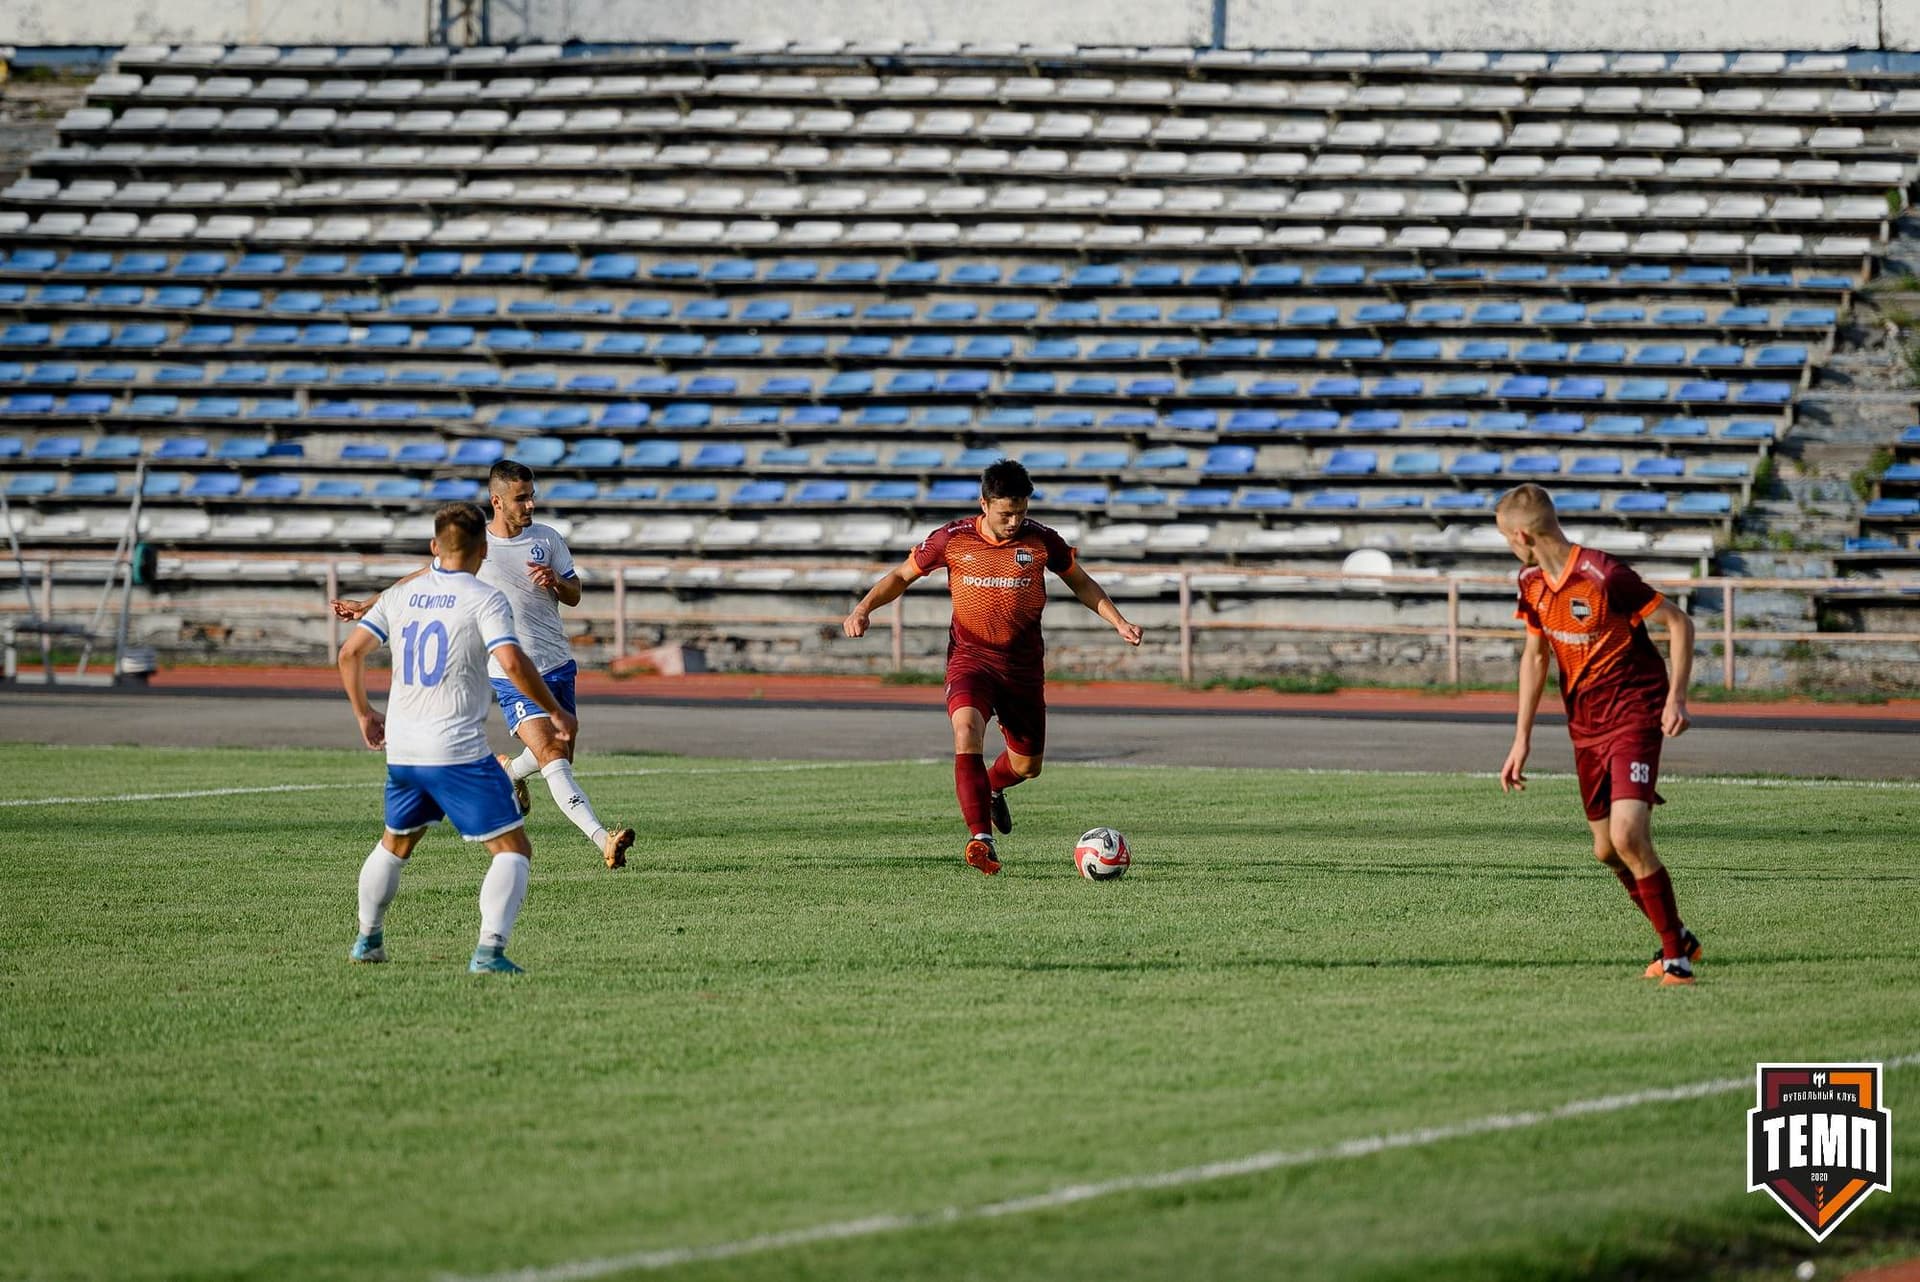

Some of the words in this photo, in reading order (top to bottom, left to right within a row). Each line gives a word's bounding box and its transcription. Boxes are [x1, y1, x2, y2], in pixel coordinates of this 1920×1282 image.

[963, 576, 1031, 588] ПРОДИНВЕСТ
[409, 593, 456, 609] ОСИПОВ
[402, 620, 449, 687] 10
[515, 701, 526, 719] 8
[1630, 761, 1649, 784] 33
